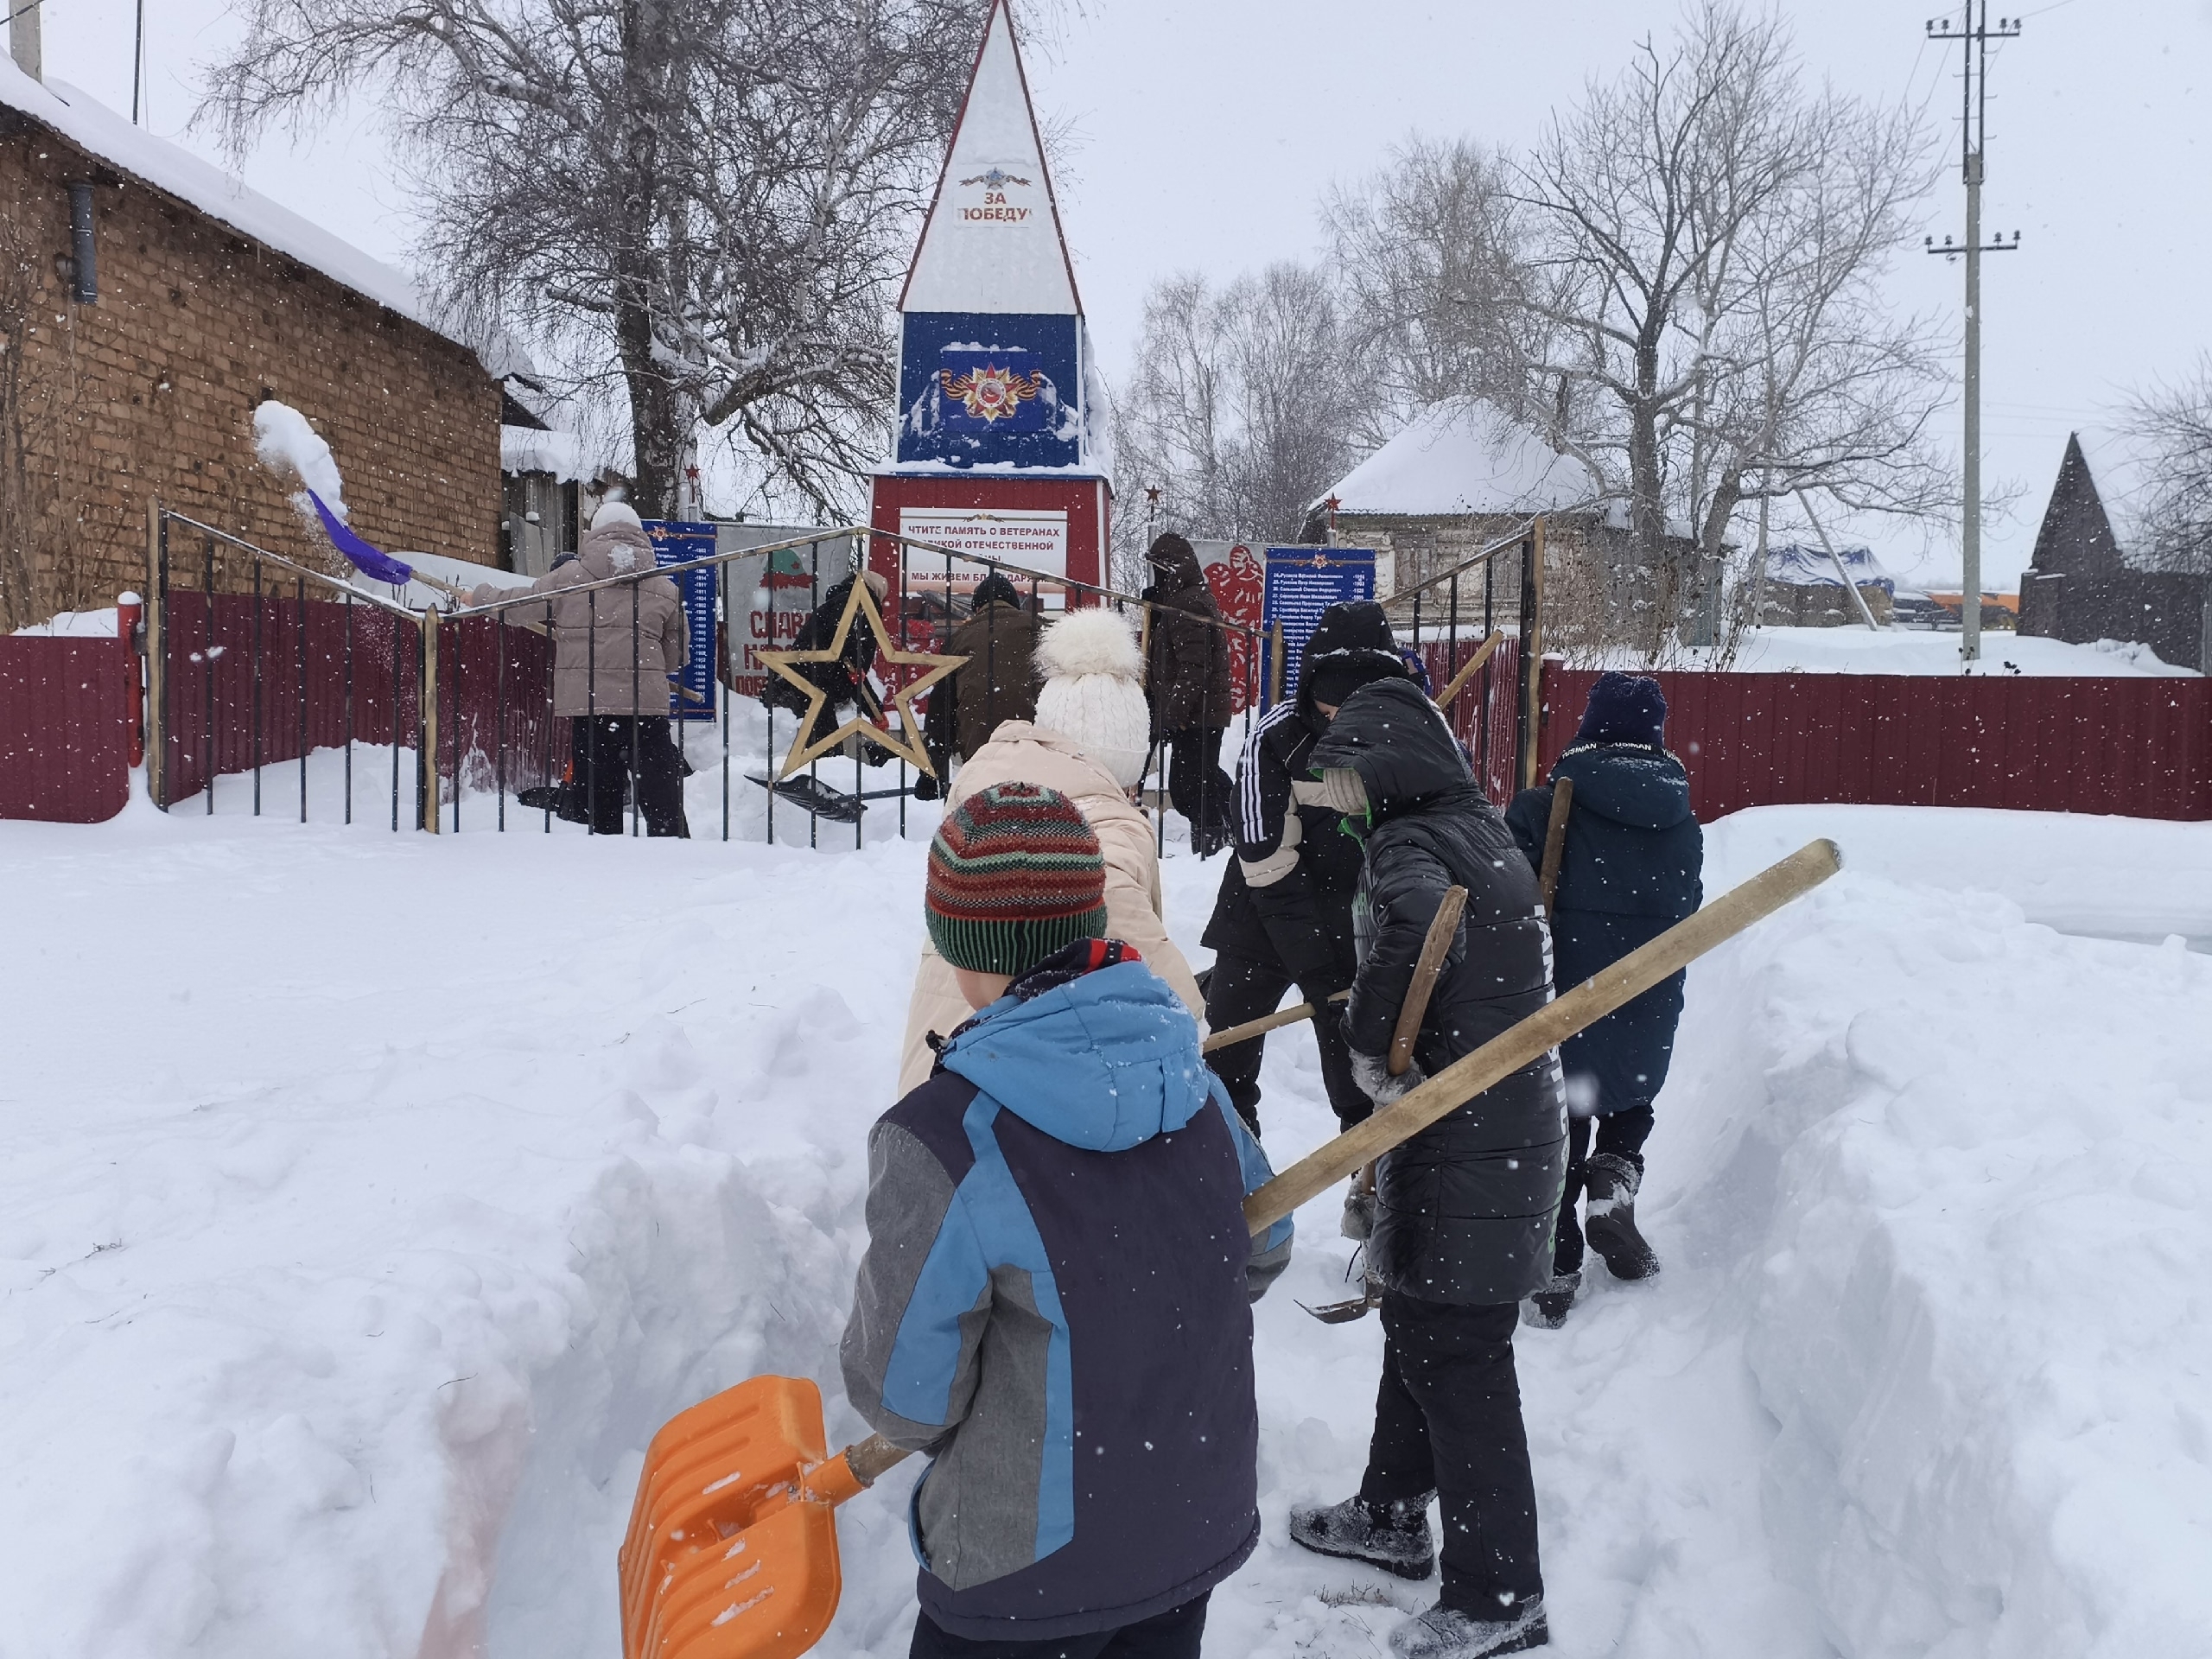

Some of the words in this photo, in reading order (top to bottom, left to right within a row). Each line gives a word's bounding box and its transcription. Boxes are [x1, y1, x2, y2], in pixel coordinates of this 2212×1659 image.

[984, 192, 1006, 204] ЗА
[909, 525, 941, 534] ЧТИТЕ
[944, 526, 986, 535] ПАМЯТЬ
[990, 527, 997, 535] О
[1000, 528, 1060, 537] ВЕТЕРАНАХ
[965, 540, 1054, 550] ОТЕЧЕСТВЕННОЙ
[973, 573, 1033, 582] БЛДАРЯ
[750, 610, 812, 639] СЛАВ
[1562, 742, 1597, 759] YUSIMAN
